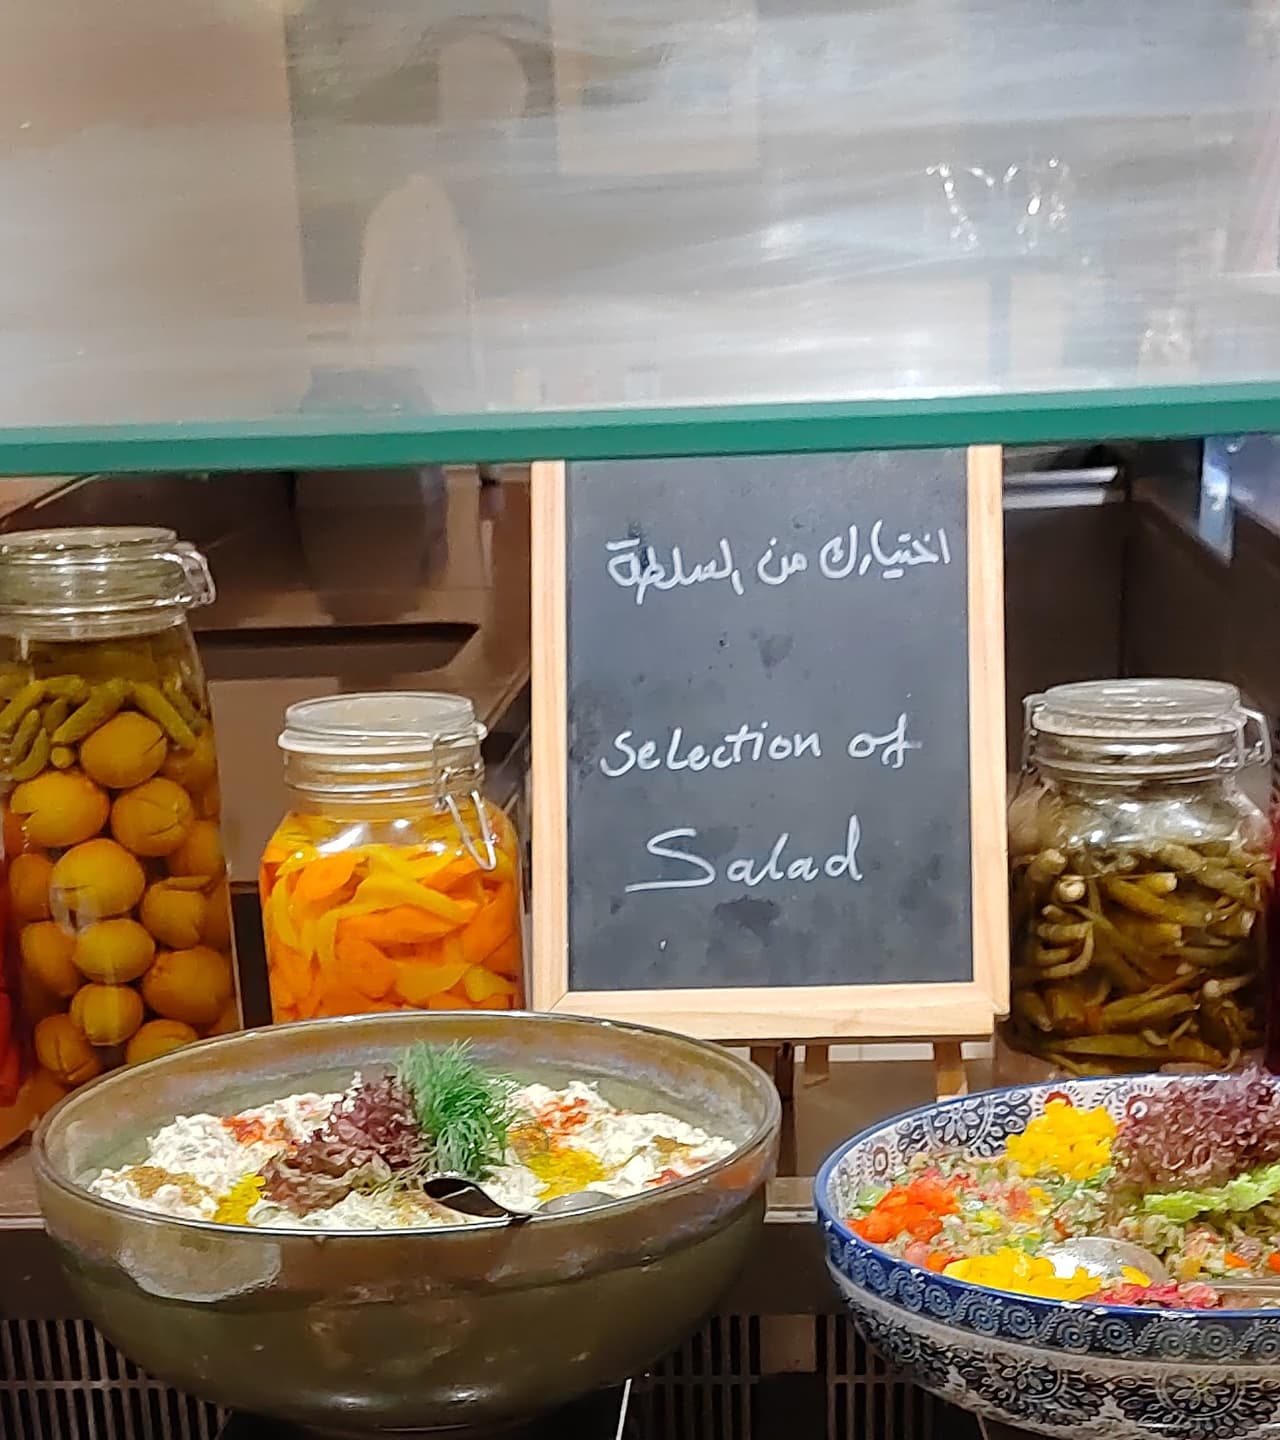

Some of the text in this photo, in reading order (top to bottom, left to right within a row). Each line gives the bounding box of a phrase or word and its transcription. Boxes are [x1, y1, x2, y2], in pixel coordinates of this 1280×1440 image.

[605, 519, 951, 604] اختيارك من السلطة
[848, 713, 922, 767] of
[625, 815, 863, 892] Salad
